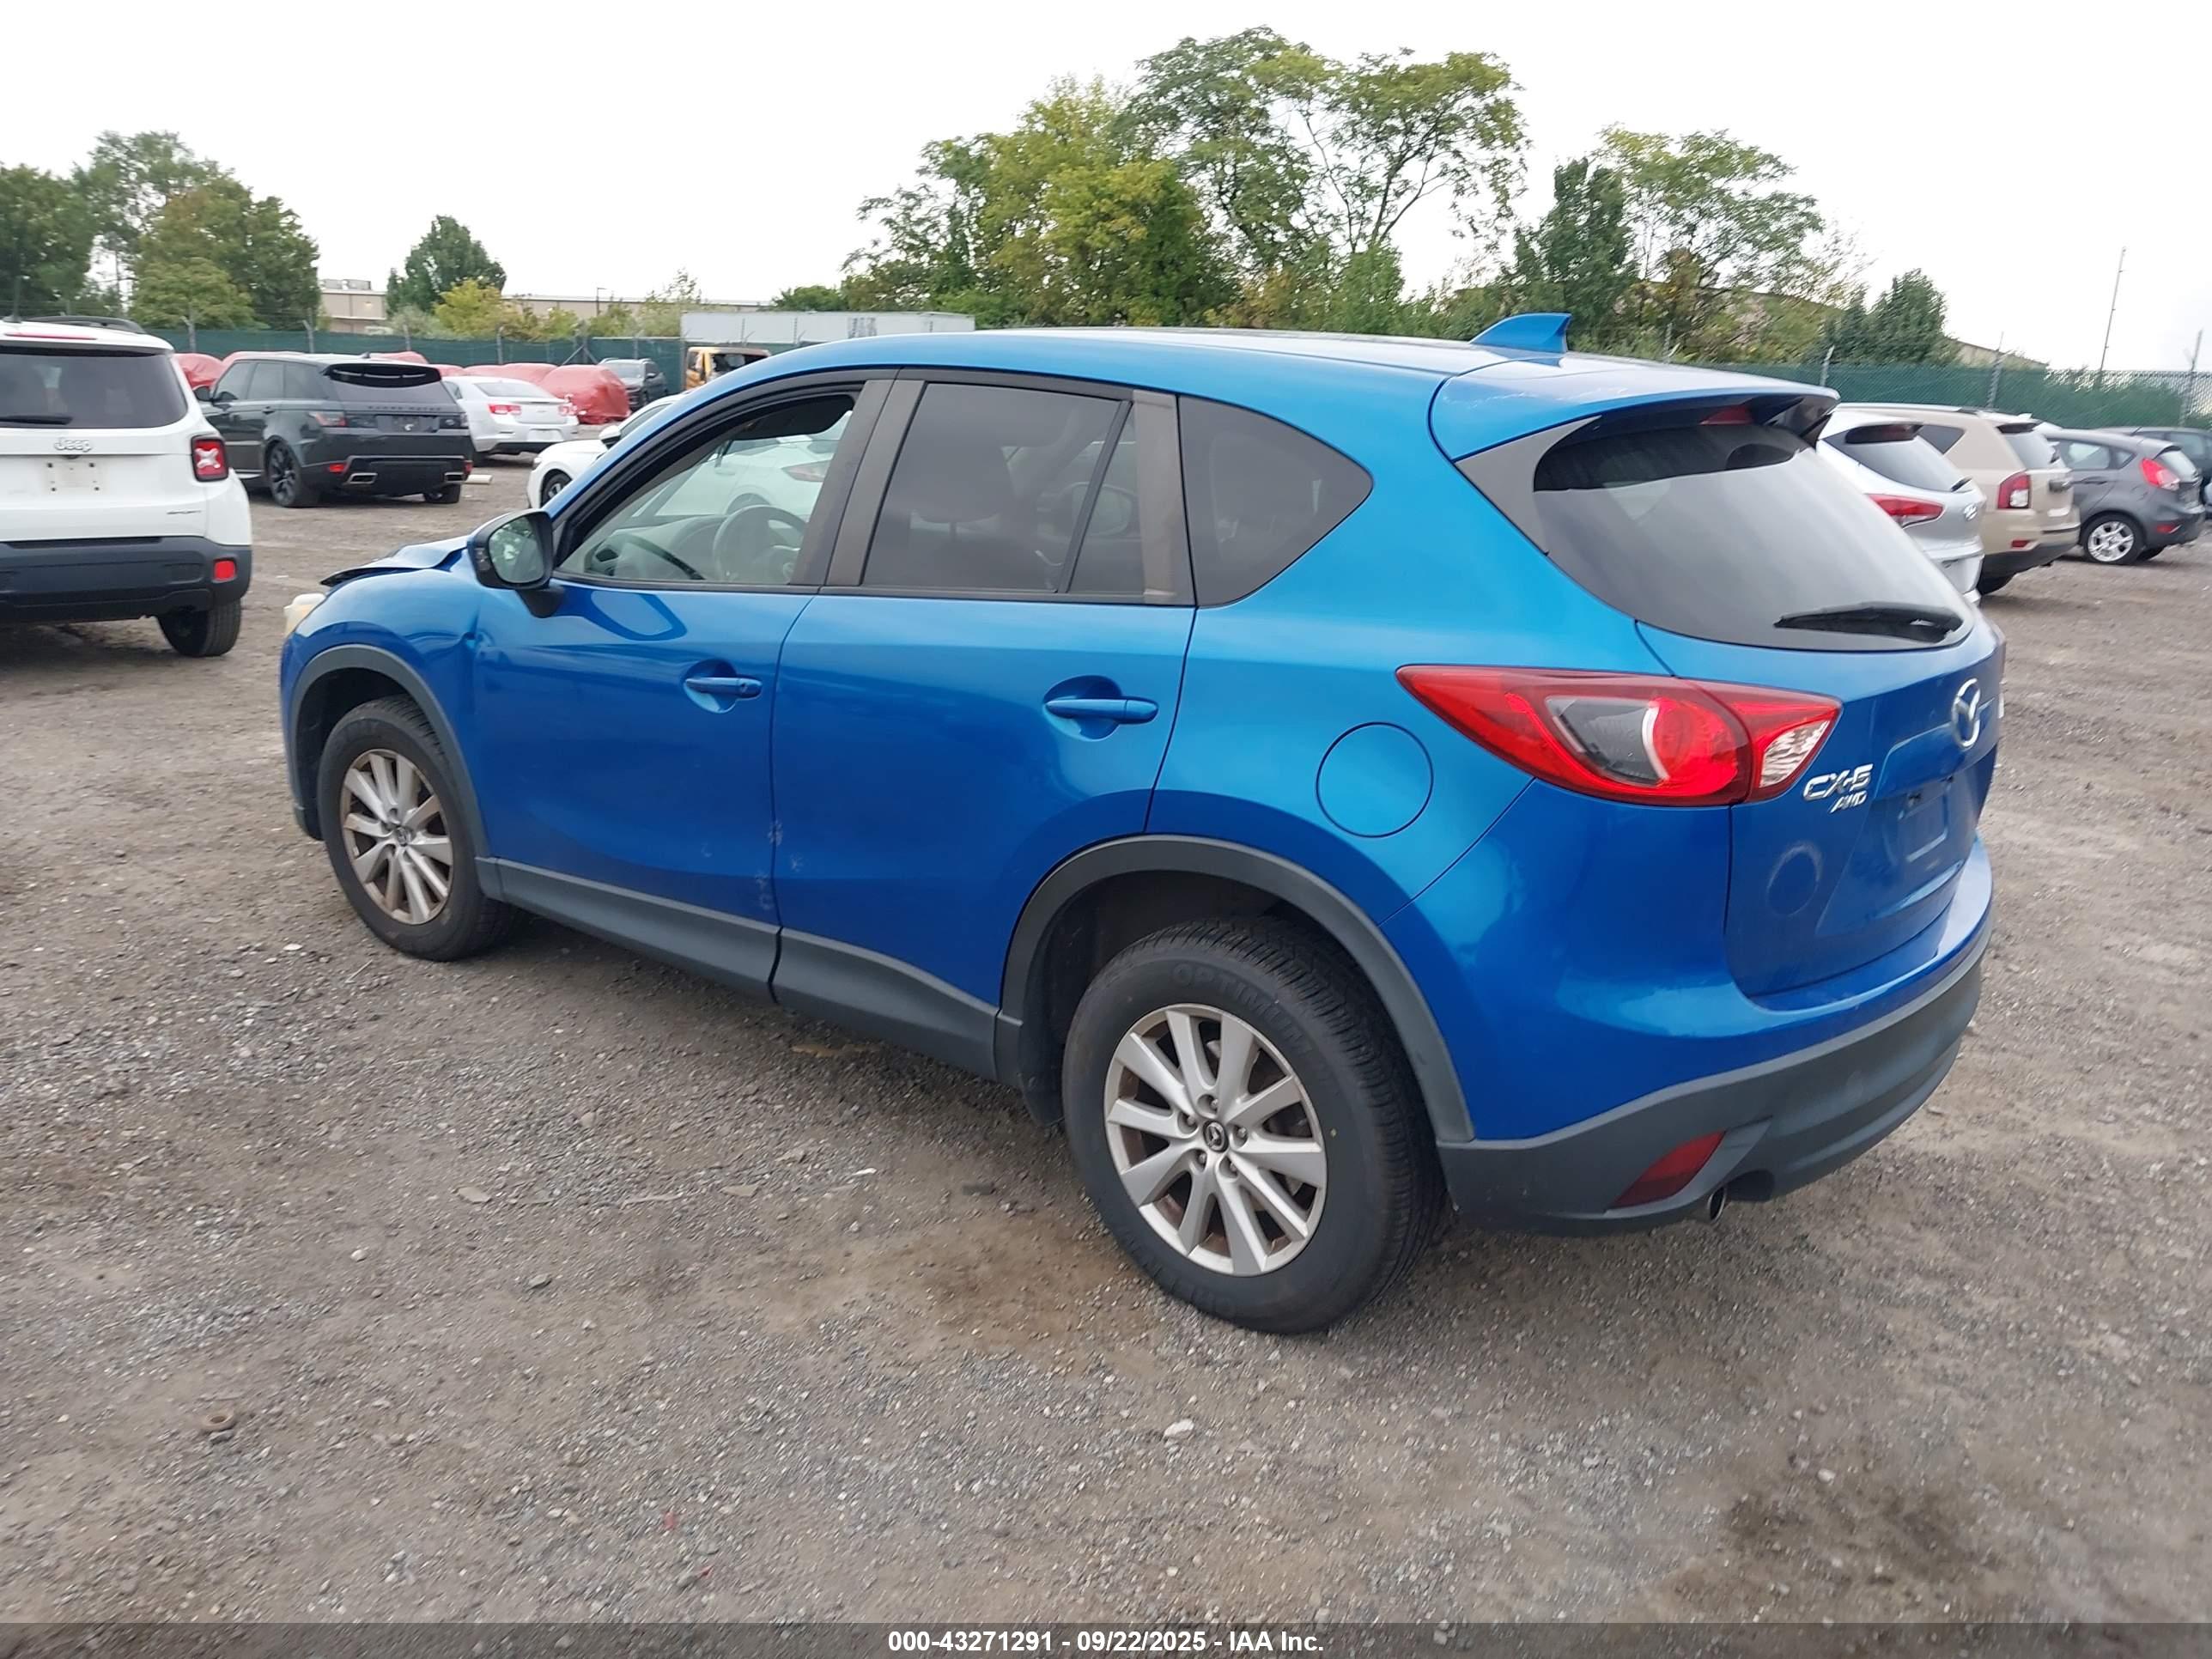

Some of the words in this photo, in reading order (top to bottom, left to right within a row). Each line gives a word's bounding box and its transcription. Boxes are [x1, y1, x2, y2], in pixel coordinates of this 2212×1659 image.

[54, 437, 92, 453] Jeep
[1803, 764, 1874, 799] CX-5
[1829, 790, 1867, 814] AWD
